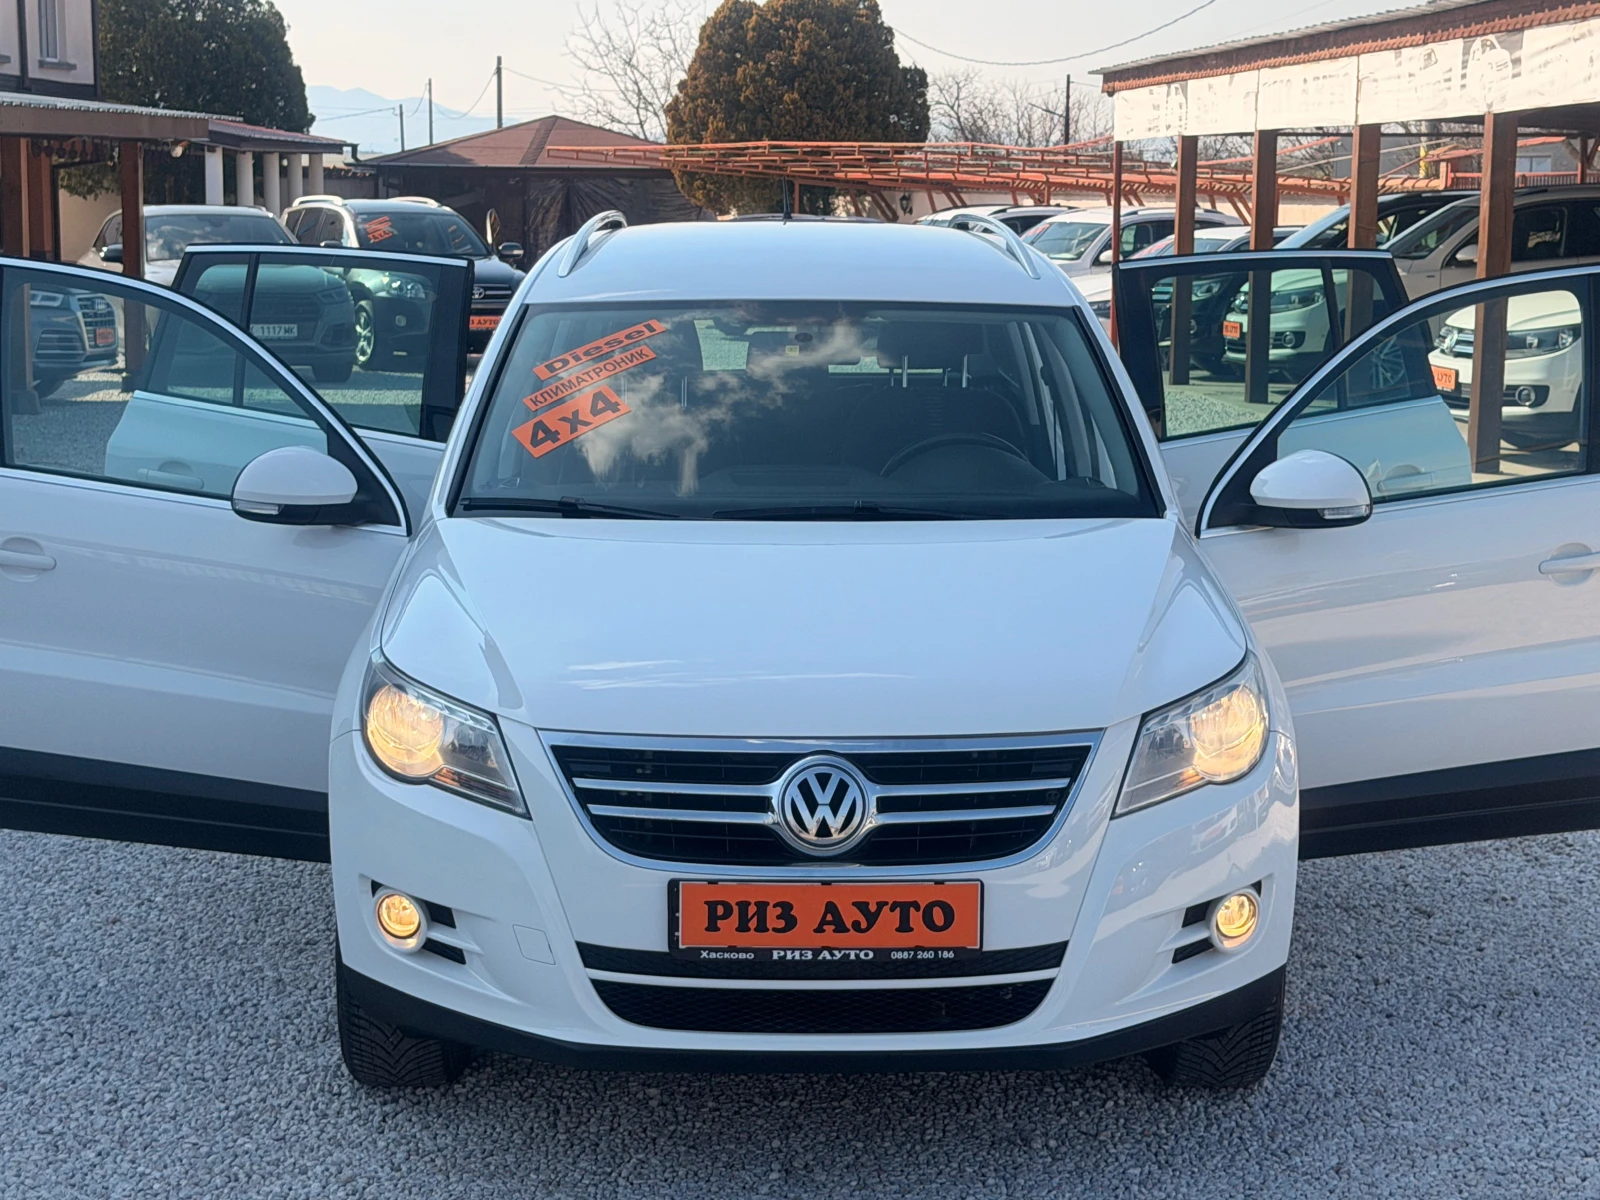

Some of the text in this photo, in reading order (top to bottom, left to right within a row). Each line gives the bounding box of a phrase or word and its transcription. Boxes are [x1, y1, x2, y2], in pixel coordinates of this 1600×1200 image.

[543, 322, 657, 374] Diesel
[529, 349, 649, 407] КЛИМАТРОНИК
[703, 900, 955, 934] РИЗ АУТО
[700, 950, 954, 960] Хасково РИЗ АУТО 0887 260 186
